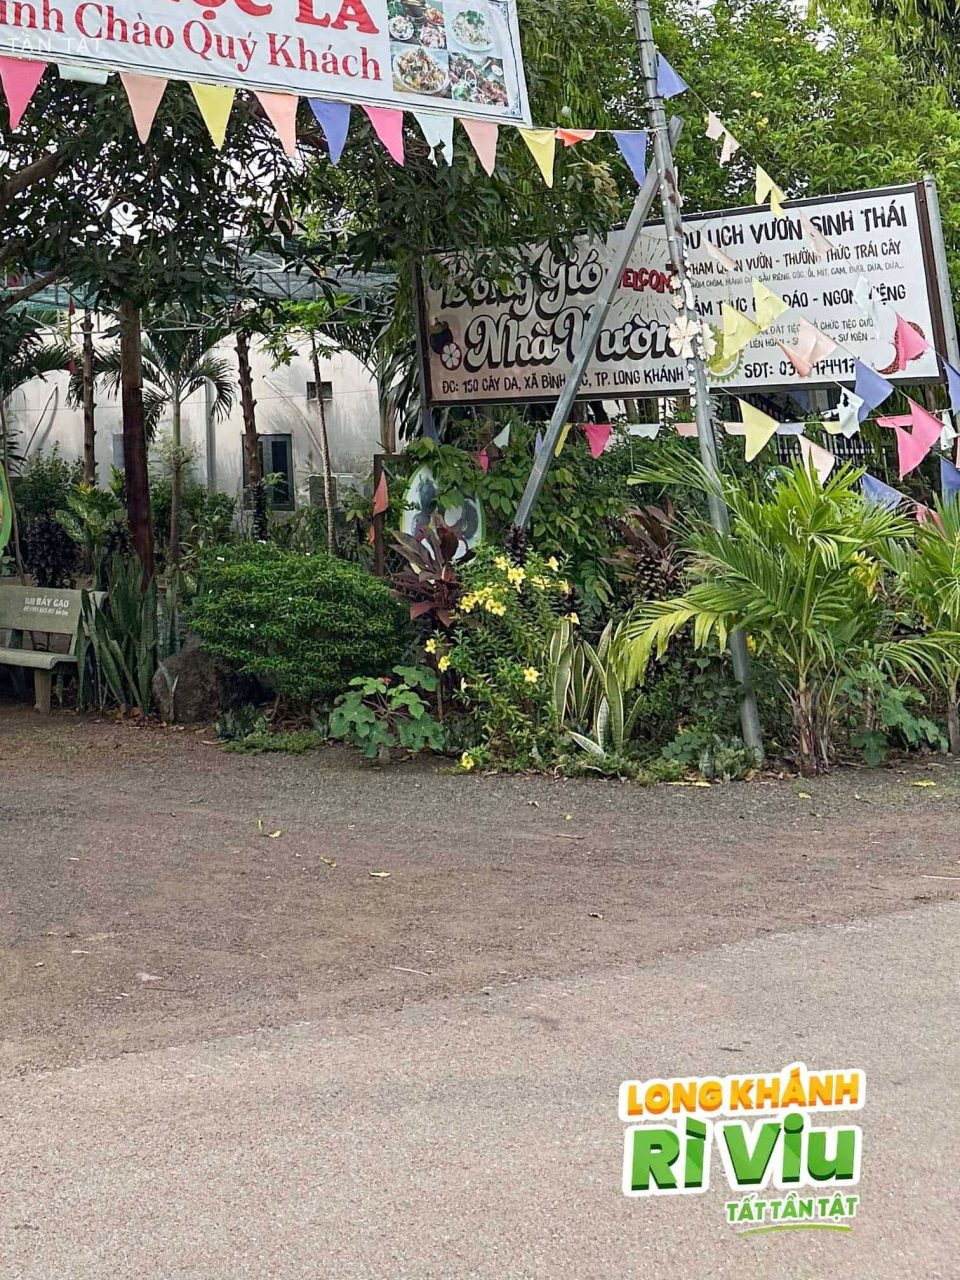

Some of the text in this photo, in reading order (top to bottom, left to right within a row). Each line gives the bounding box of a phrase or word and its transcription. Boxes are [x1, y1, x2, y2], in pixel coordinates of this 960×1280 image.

[74, 2, 175, 49] Chào
[182, 20, 258, 72] Quý
[266, 32, 383, 81] Khách
[810, 209, 855, 237] SINH
[861, 199, 907, 232] THÁI
[783, 246, 821, 266] THƯỞN
[854, 238, 879, 260] TRÁI
[617, 267, 676, 294] ELCOM
[464, 315, 560, 372] Nhà
[613, 369, 641, 385] LONG
[644, 364, 685, 384] KHÁNH
